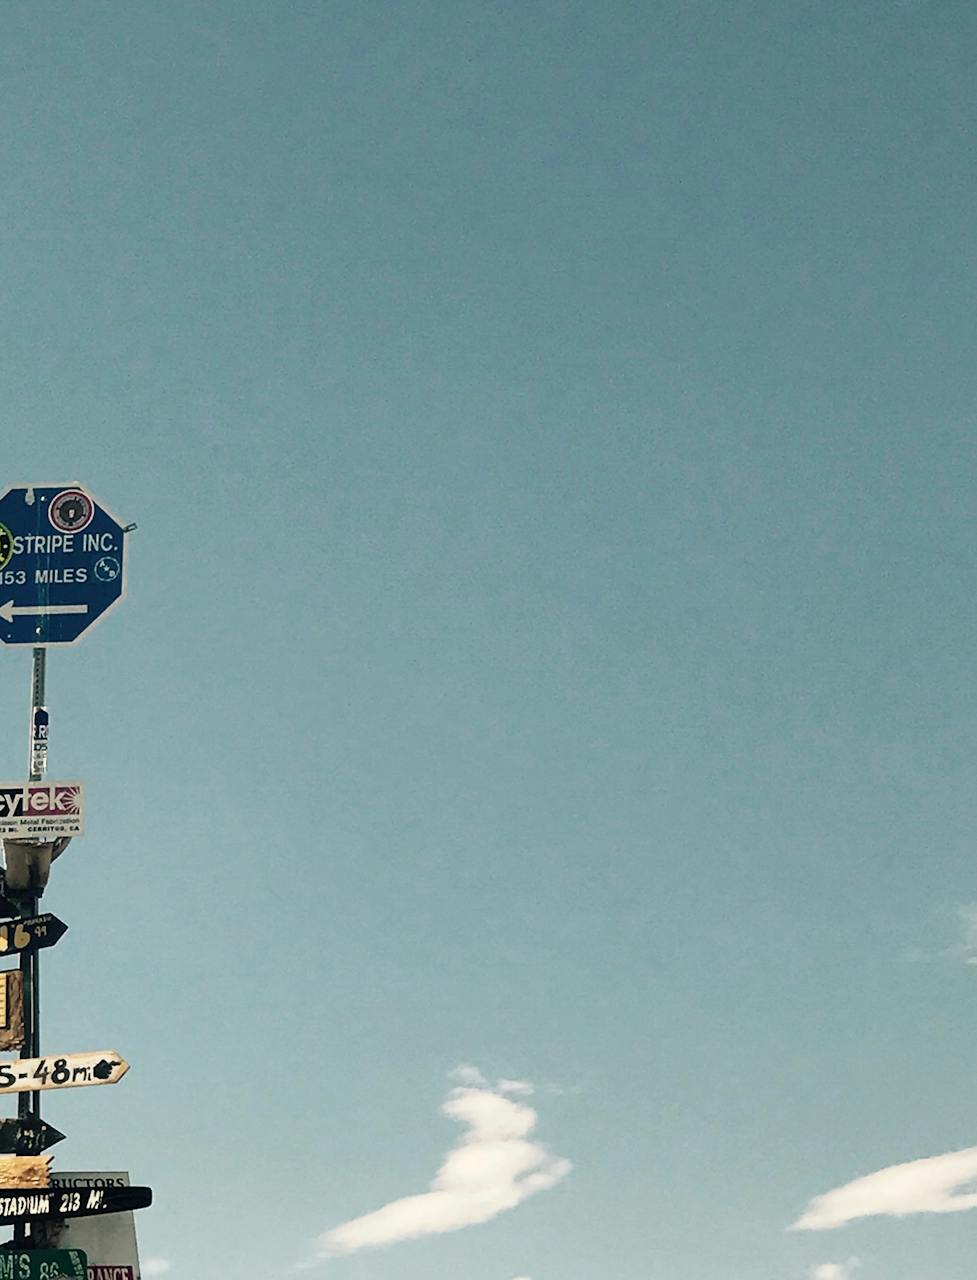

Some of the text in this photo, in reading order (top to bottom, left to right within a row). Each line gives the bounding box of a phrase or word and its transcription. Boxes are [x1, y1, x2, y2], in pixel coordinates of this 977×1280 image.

[13, 533, 74, 554] STRIPE
[82, 532, 118, 552] INC.
[35, 568, 88, 584] MILES
[59, 1192, 81, 1213] 213
